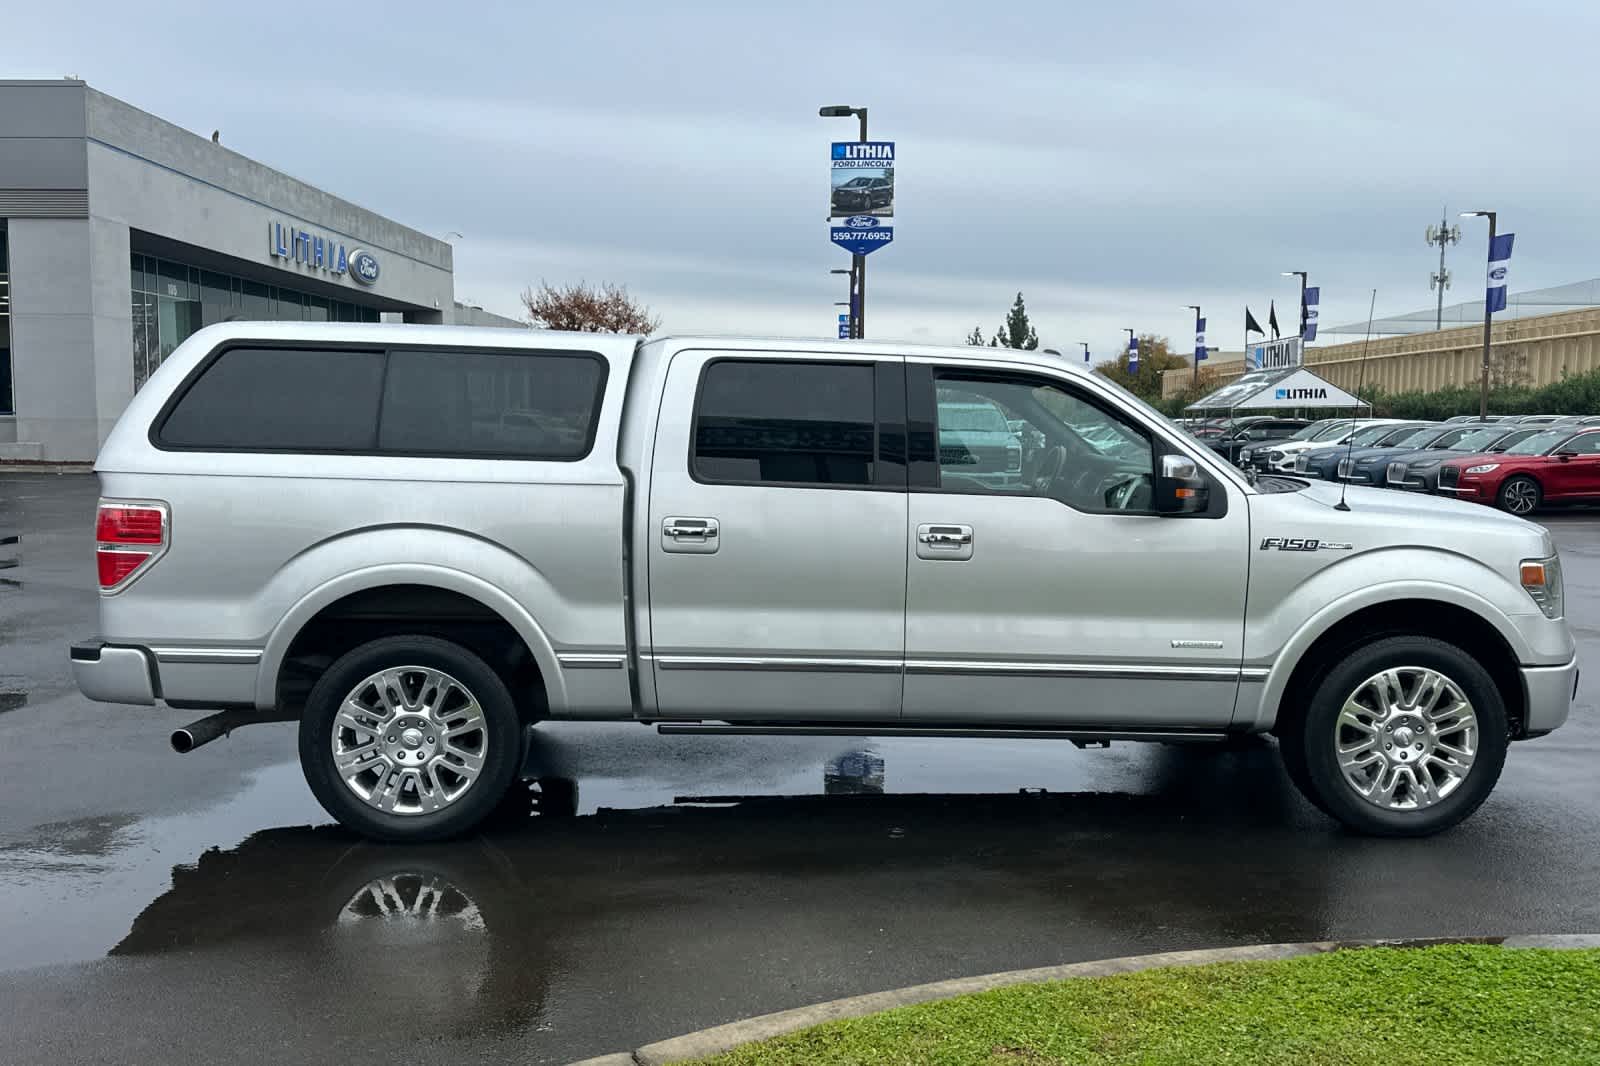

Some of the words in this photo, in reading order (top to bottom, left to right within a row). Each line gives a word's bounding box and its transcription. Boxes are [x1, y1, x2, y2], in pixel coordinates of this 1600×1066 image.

[845, 145, 893, 158] LITHIA
[833, 160, 856, 168] FORD
[858, 160, 893, 168] LINCOLN
[850, 216, 874, 228] Ford
[832, 231, 891, 241] 559.777.6952
[269, 222, 347, 275] LITHIA
[360, 256, 377, 278] Ford
[1262, 343, 1290, 368] LITHIA
[1287, 388, 1328, 400] LITHIA
[1260, 537, 1320, 552] F-150
